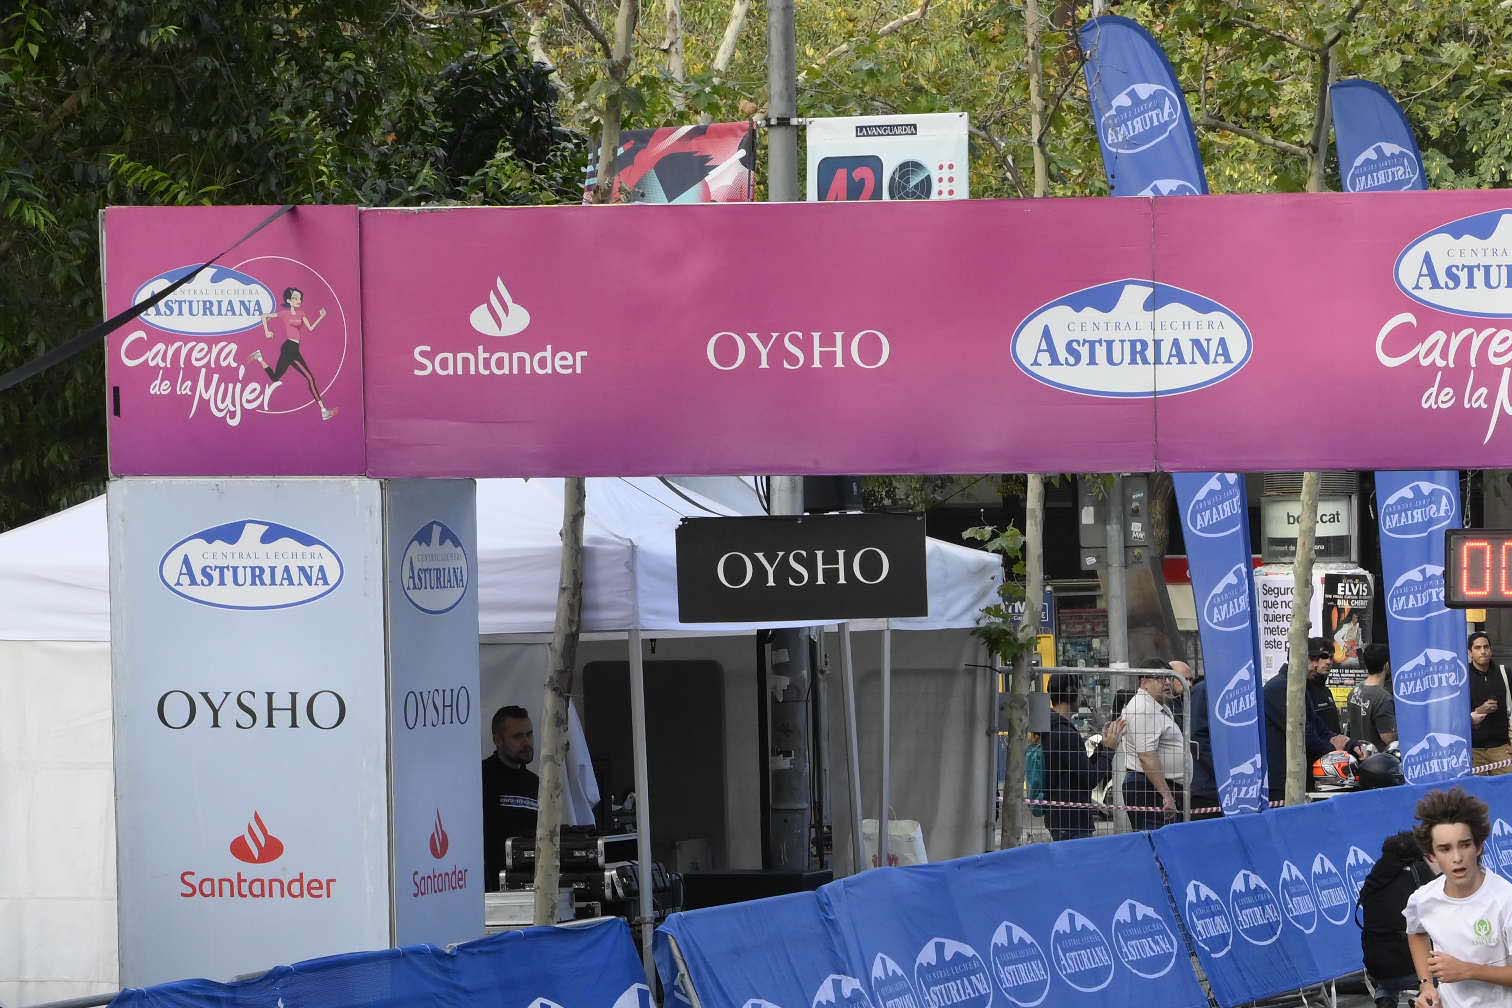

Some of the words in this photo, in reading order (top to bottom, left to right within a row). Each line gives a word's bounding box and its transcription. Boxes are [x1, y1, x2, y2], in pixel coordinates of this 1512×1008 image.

[868, 126, 915, 135] VANGUARDIA
[144, 290, 264, 316] ASTURIANA
[1067, 321, 1141, 332] CENTRAL
[1150, 320, 1225, 331] LECHERA
[121, 331, 238, 368] Carrera
[413, 344, 587, 376] Santander
[706, 329, 891, 371] OYSHO
[1030, 324, 1234, 367] ASTURIANA
[150, 370, 171, 395] de
[177, 368, 191, 395] la
[189, 365, 282, 426] Mujer
[1421, 371, 1456, 409] de
[1463, 370, 1488, 409] la
[1287, 511, 1340, 525] b.cat
[174, 554, 330, 587] ASTURIANA
[202, 552, 260, 560] CENTRAL
[265, 552, 324, 560] LECHERA
[717, 547, 890, 589] OYSHO
[406, 555, 465, 591] ASTURIANA
[1337, 583, 1368, 595] ELVIS
[1263, 600, 1278, 610] que
[1264, 610, 1295, 625] quiere
[1265, 638, 1282, 649] este
[157, 690, 346, 730] OYSHO
[404, 685, 470, 730] OYSHO
[180, 870, 336, 899] Santander
[413, 864, 468, 898] Santander
[995, 956, 1047, 988] ASTURIANA
[1057, 943, 1111, 974] ASTURIANA
